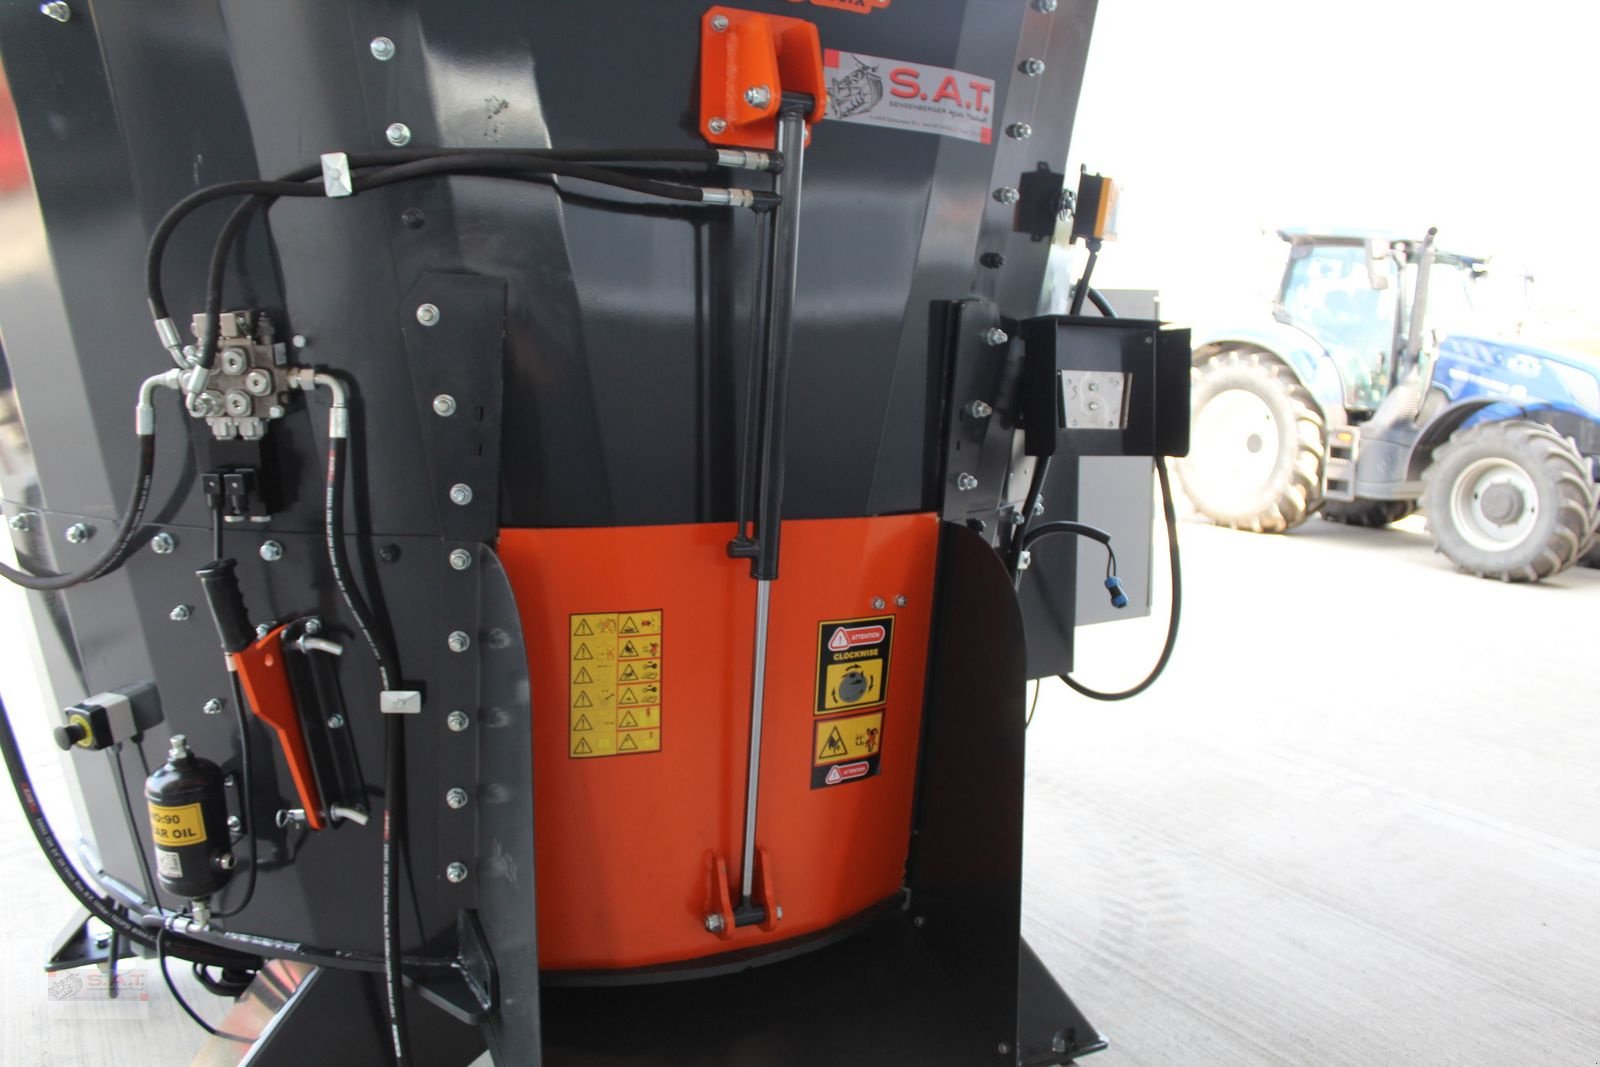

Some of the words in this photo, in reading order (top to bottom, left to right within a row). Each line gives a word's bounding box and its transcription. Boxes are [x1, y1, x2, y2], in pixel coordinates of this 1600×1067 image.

[889, 67, 991, 114] S.A.T.
[851, 631, 880, 641] ATTENTION
[833, 648, 879, 661] CLOCKWISE
[843, 766, 866, 776] ATTENTION
[172, 828, 196, 838] OIL
